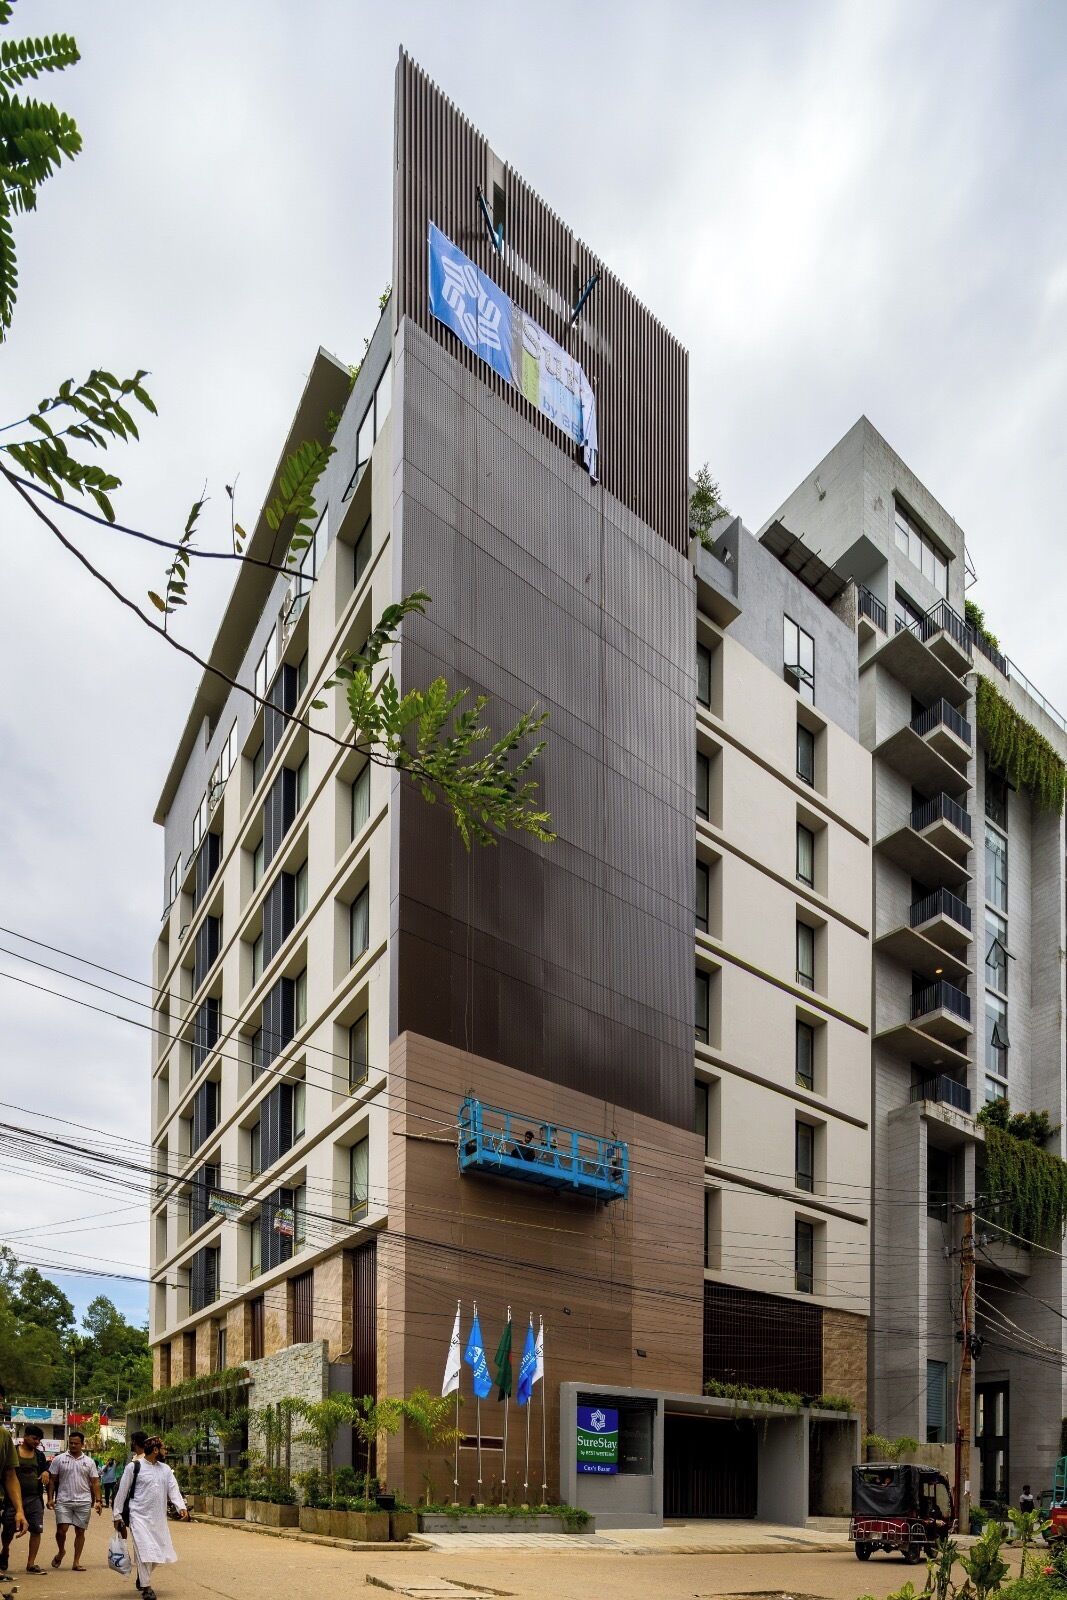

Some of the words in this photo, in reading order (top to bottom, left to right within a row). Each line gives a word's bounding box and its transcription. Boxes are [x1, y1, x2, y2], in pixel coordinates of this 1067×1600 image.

[522, 322, 579, 396] Sur
[543, 396, 558, 419] by
[562, 414, 582, 439] BE
[577, 1435, 617, 1452] SureStay
